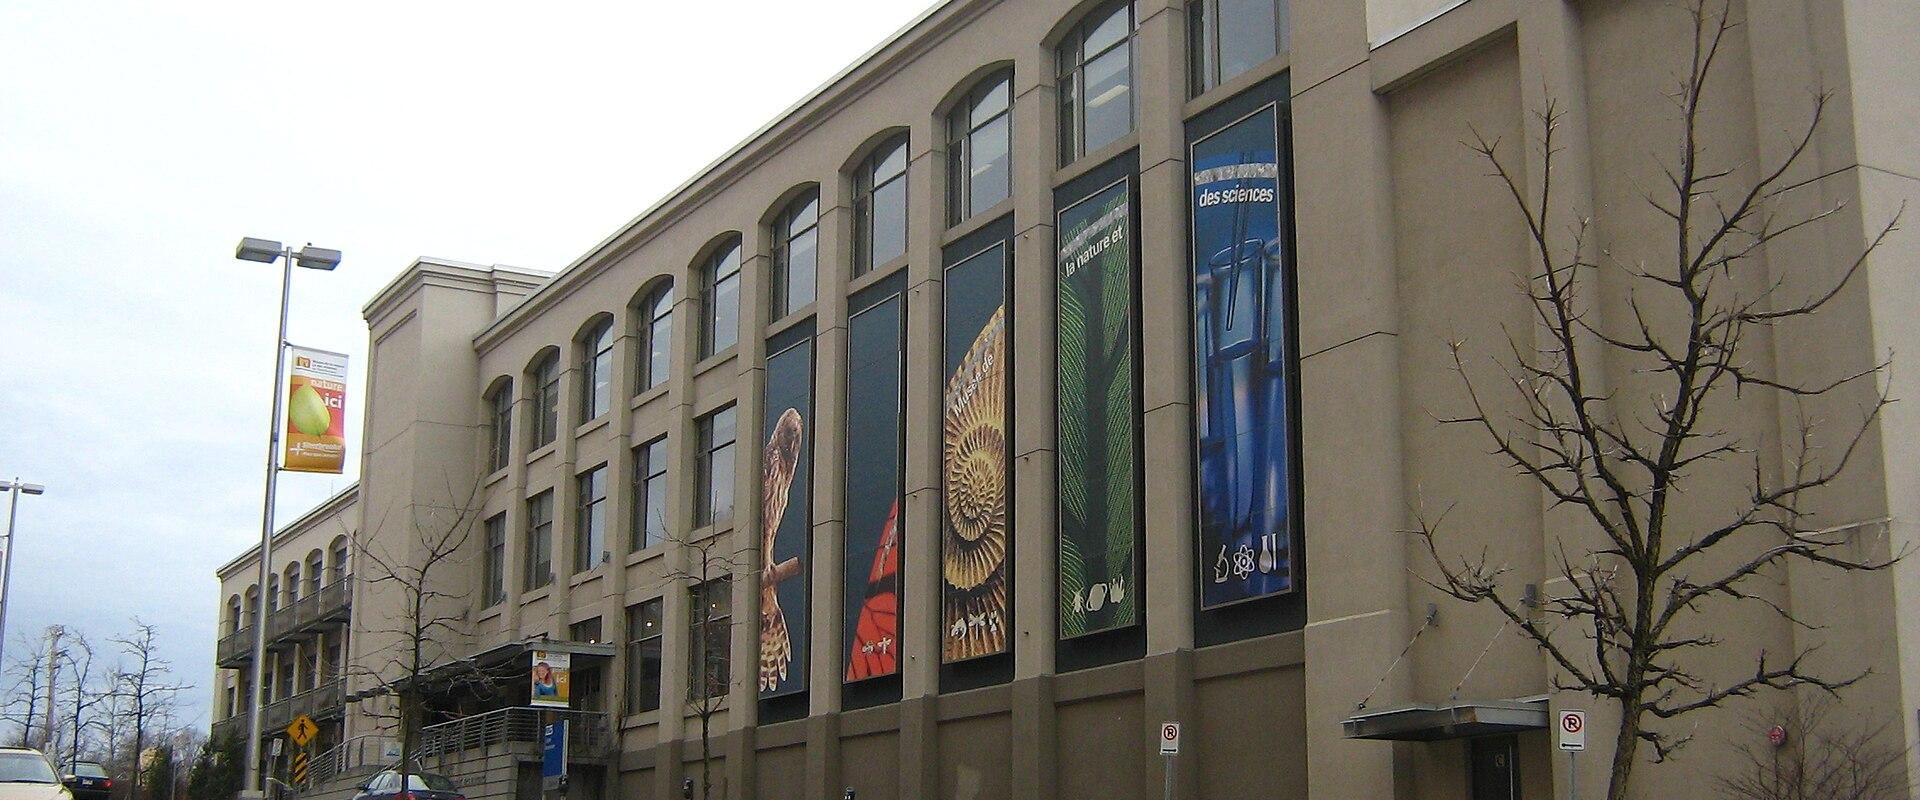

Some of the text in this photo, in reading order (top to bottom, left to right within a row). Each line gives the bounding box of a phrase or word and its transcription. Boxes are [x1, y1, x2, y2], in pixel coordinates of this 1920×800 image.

[1199, 184, 1274, 207] des sciences
[1065, 224, 1123, 277] la nature et
[981, 348, 994, 373] de
[310, 378, 343, 391] nature
[324, 392, 343, 410] ici
